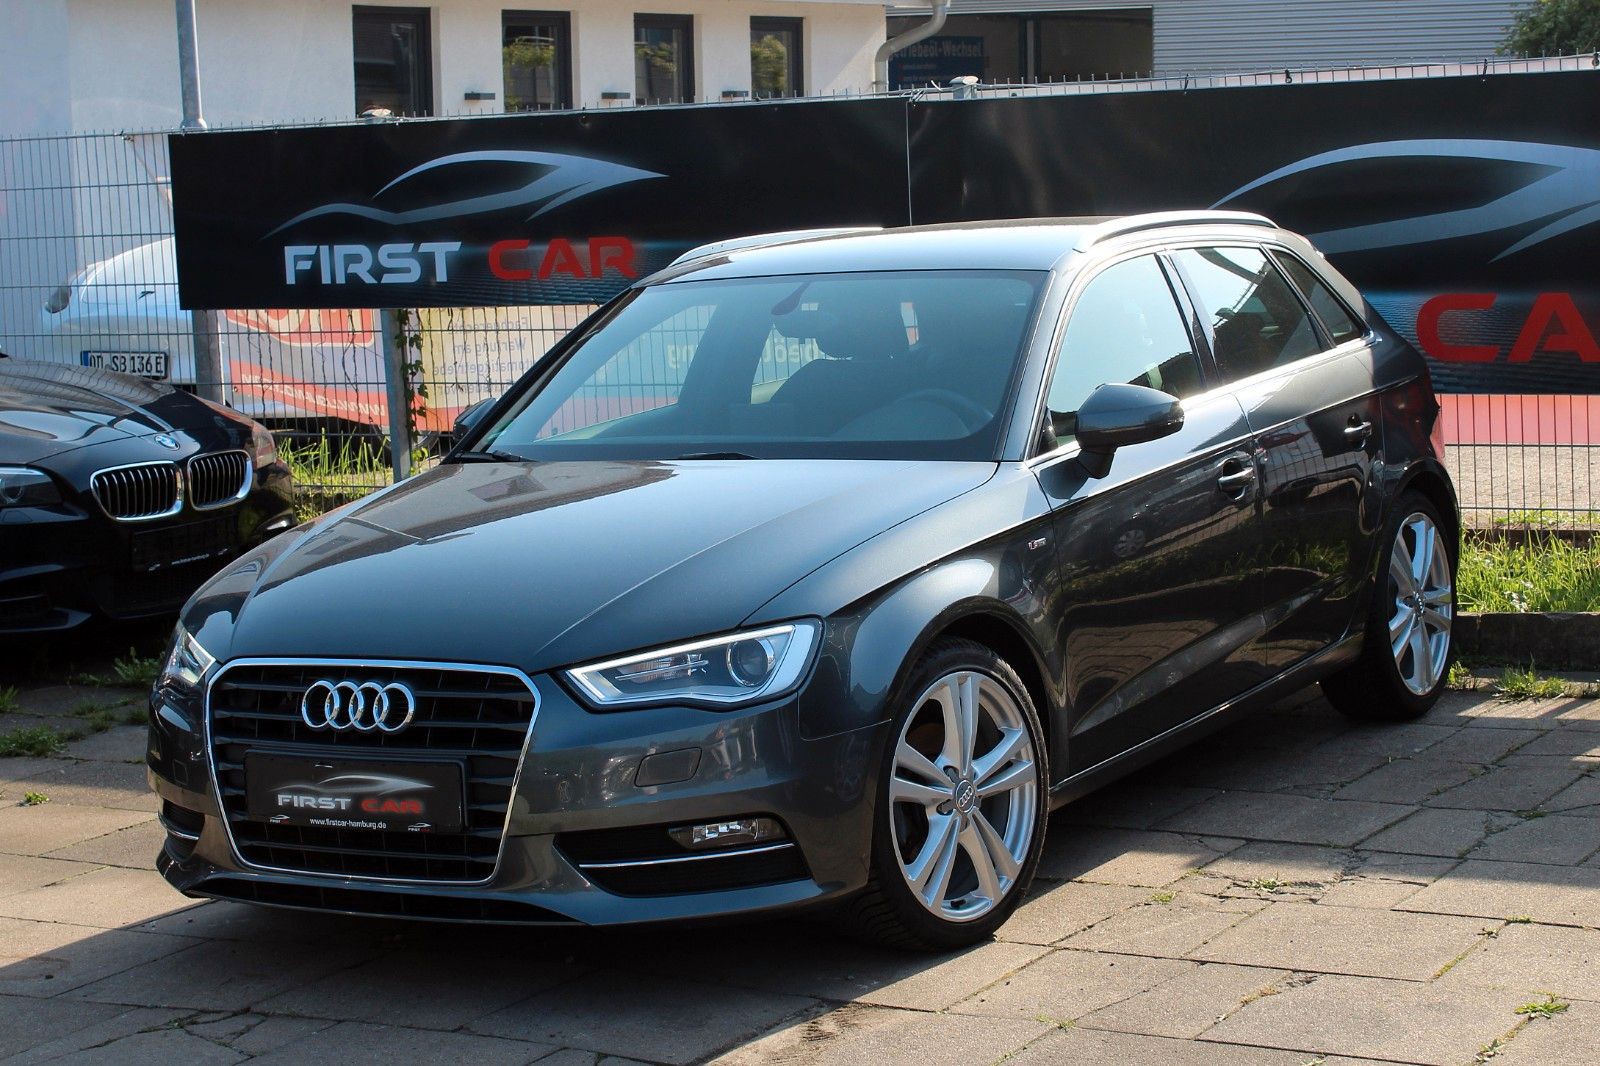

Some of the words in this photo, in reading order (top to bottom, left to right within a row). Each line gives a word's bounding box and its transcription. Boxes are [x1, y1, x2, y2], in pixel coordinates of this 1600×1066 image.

[284, 241, 462, 284] FIRST
[488, 236, 638, 281] CAR
[112, 355, 127, 373] SB
[277, 794, 351, 810] FIRST
[361, 799, 423, 815] CAR
[309, 818, 387, 830] www.firstcar-hamburg.de
